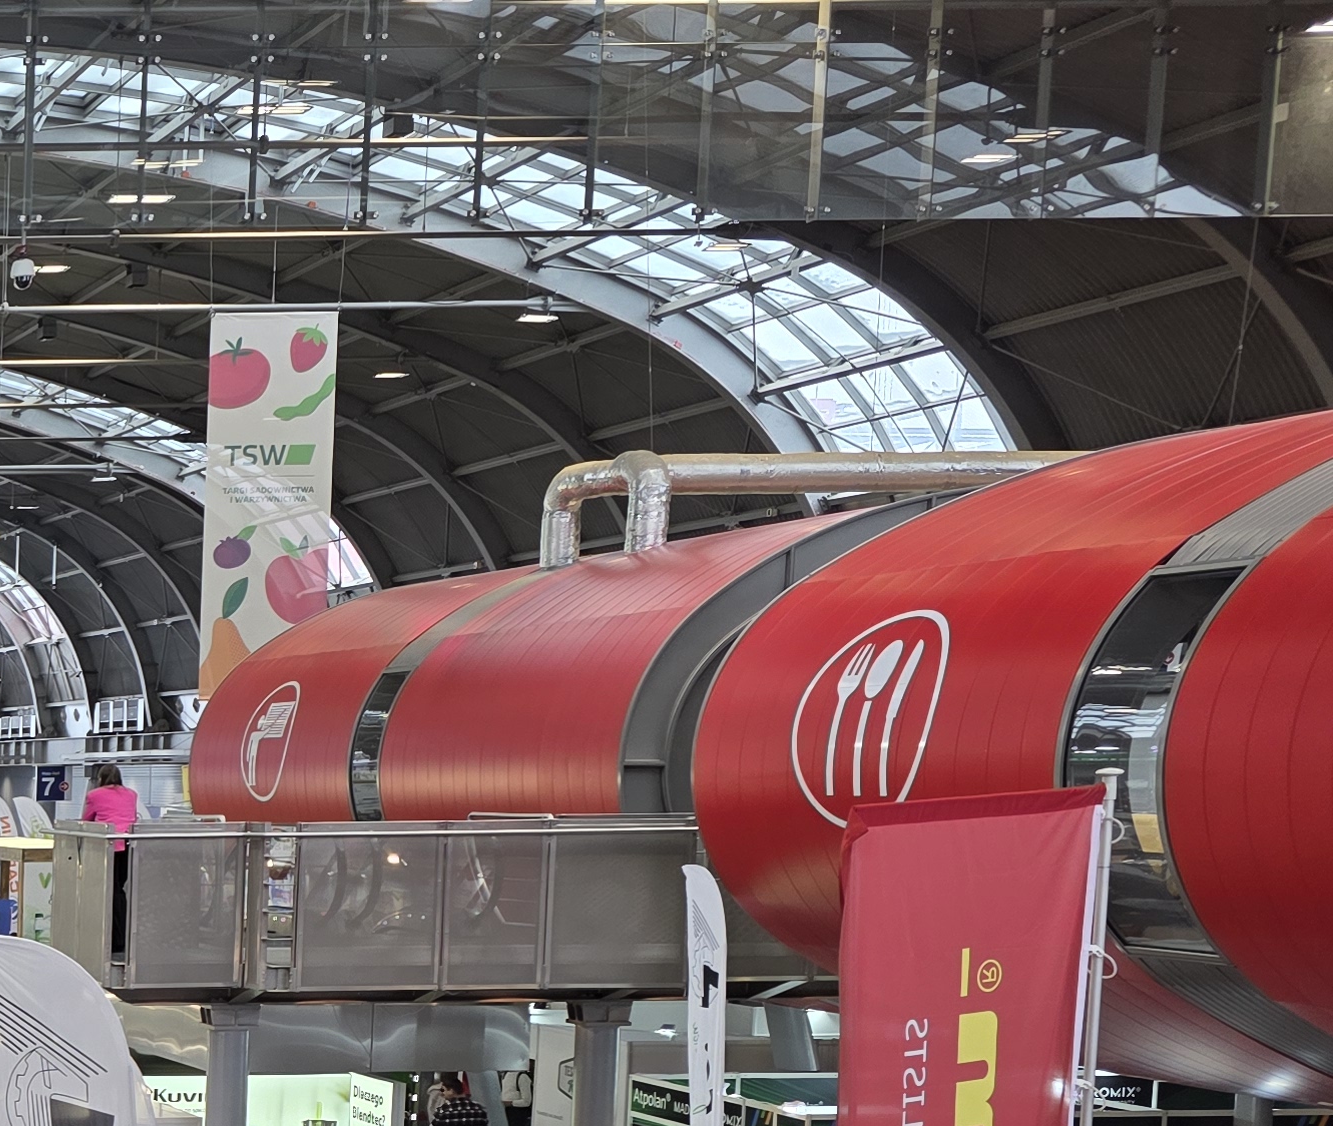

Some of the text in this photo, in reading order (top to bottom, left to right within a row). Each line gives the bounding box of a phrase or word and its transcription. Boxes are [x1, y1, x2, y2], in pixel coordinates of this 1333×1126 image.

[224, 444, 287, 466] TSW
[250, 486, 314, 494] SADOWNICTWA
[235, 495, 307, 503] WARZYWNICTWA
[41, 777, 55, 796] 7
[353, 1085, 384, 1108] Dlaczego
[673, 1101, 690, 1115] MAD
